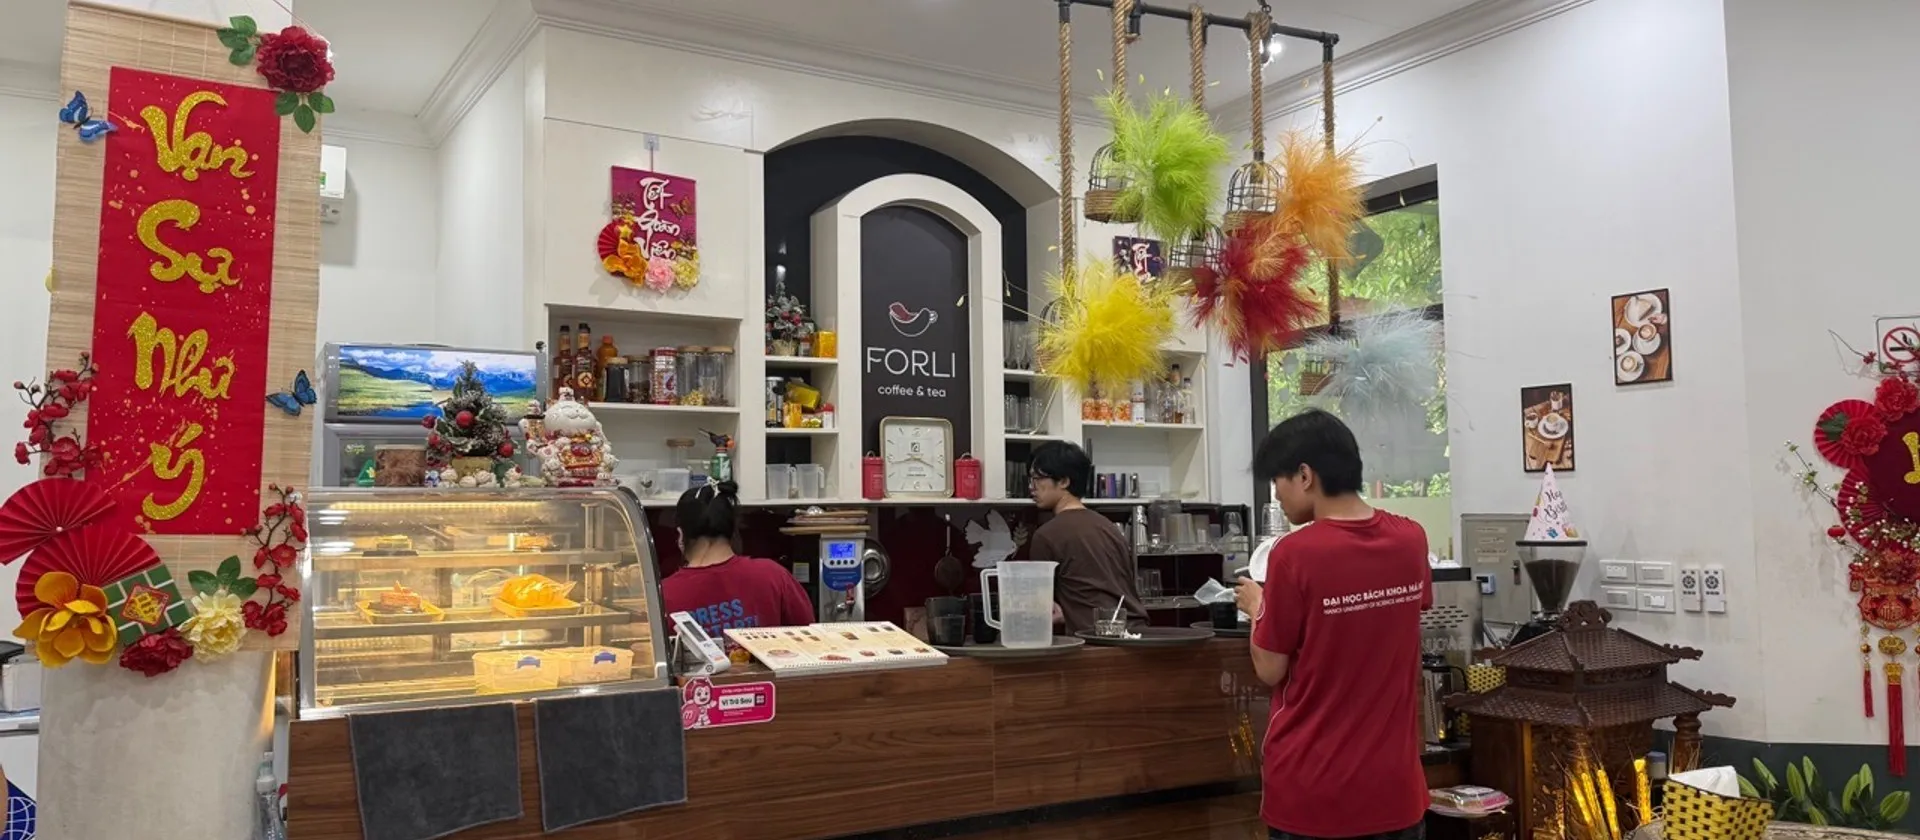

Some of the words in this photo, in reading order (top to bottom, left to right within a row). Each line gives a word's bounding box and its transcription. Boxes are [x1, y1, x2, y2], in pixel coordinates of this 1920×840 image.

[139, 90, 256, 181] Vạn
[136, 199, 241, 294] Sự
[866, 346, 956, 379] FORLI
[877, 384, 914, 397] coffee
[916, 385, 925, 397] &
[926, 387, 947, 398] tea
[1386, 585, 1408, 597] KHOA
